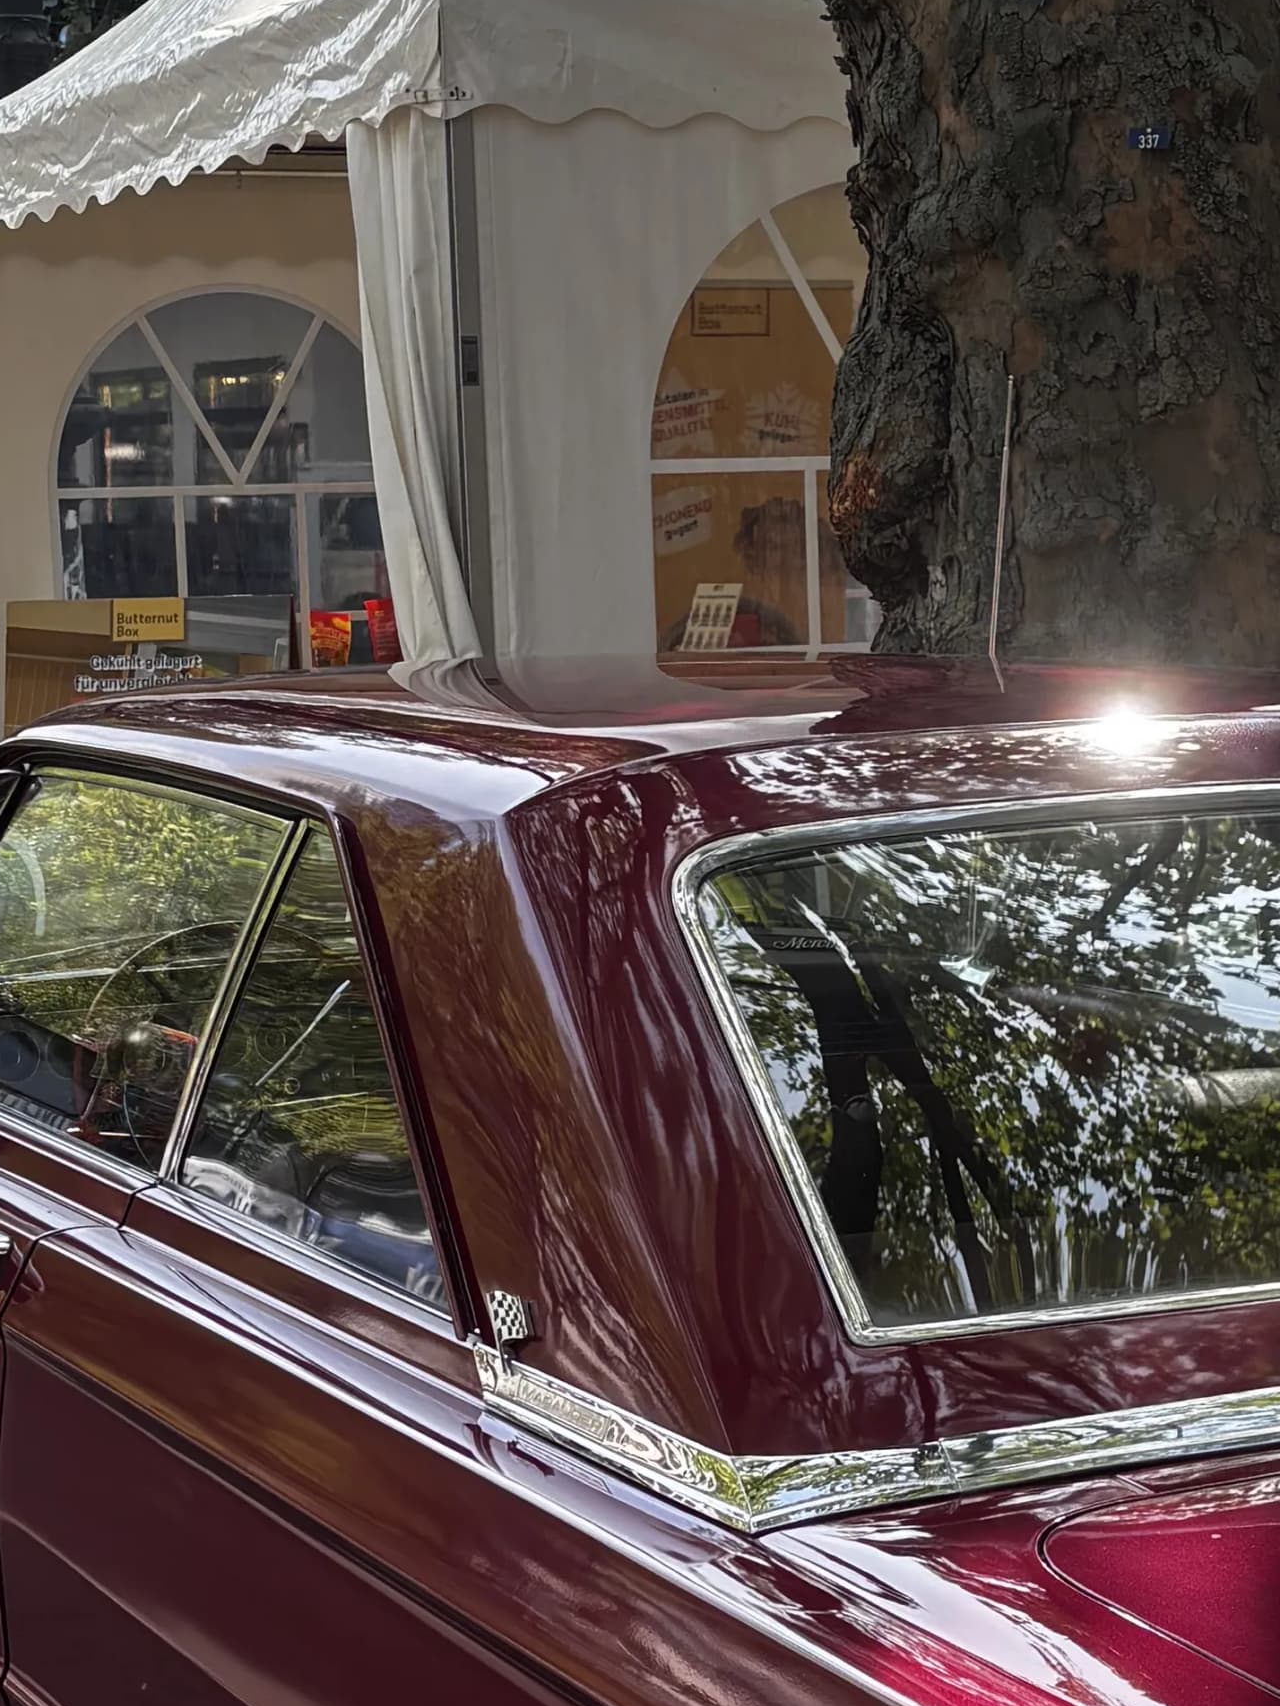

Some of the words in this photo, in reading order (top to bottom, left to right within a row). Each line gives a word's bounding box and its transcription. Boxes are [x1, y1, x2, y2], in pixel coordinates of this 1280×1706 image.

[1138, 134, 1160, 149] 337
[116, 613, 179, 625] Butternut
[116, 626, 139, 638] Box
[75, 674, 98, 692] für
